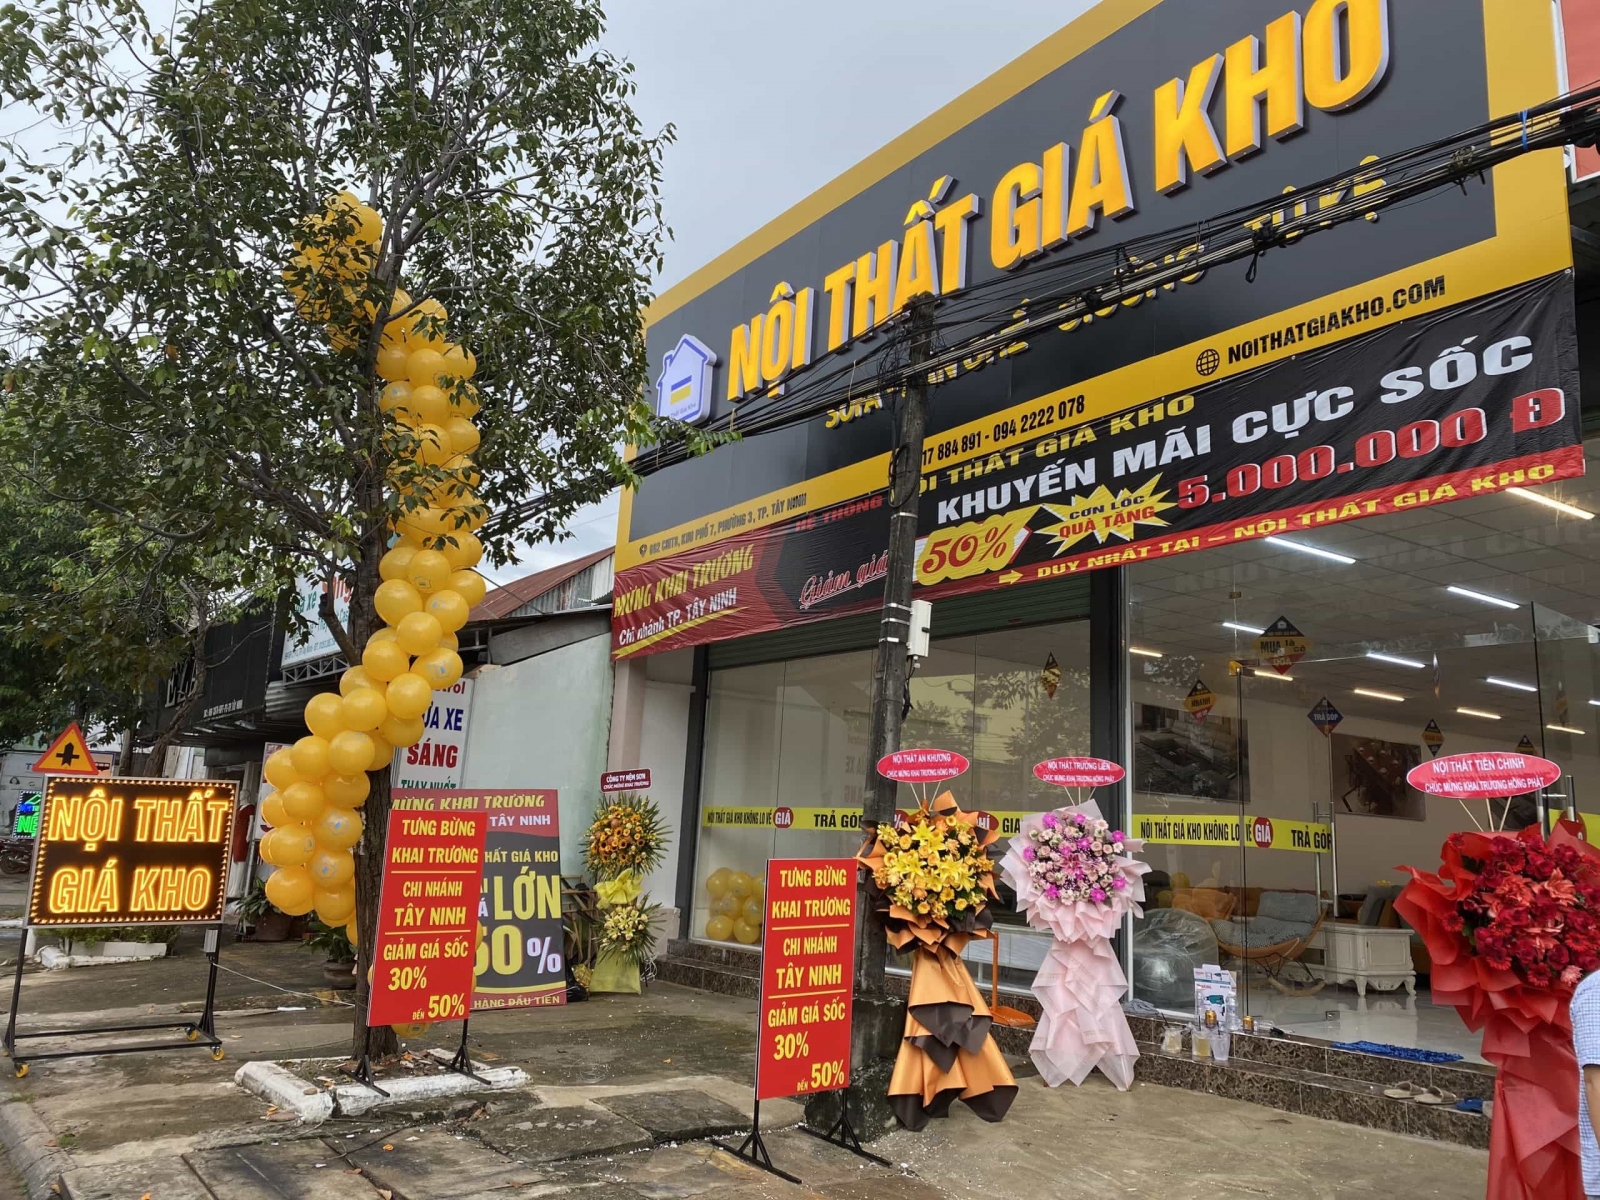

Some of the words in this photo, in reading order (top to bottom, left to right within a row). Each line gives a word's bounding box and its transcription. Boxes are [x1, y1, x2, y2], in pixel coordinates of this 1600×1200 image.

[727, 281, 814, 401] NỘI
[824, 174, 979, 352] THẤT
[991, 89, 1134, 271] GIÁ
[1154, 0, 1389, 195] KHO
[1228, 277, 1445, 364] NOITHATGIAKHO.COM
[938, 439, 958, 460] 884
[962, 431, 981, 453] 891
[994, 419, 1016, 442] 094
[1021, 402, 1053, 433] 2222
[1059, 394, 1085, 420] 078
[1110, 394, 1195, 436] KHO
[938, 457, 1095, 525] KHUYẾN
[1113, 425, 1210, 478] MÃI
[1232, 386, 1354, 443] CỰC
[1380, 335, 1533, 404] SỐC
[1177, 408, 1486, 509] 5.000.000
[1510, 387, 1565, 433] Đ
[748, 512, 755, 524] 3,
[757, 506, 768, 520] TP.
[772, 499, 785, 515] TÂY
[1037, 561, 1079, 578] DUY
[1087, 545, 1152, 568] NHẤT
[1160, 536, 1199, 553] TẠI
[1234, 517, 1287, 540] NỘI
[1298, 498, 1382, 526] THẤT
[1395, 482, 1457, 508] GIÁ
[1471, 464, 1554, 492] KHO
[1069, 504, 1104, 520] CƠN
[1111, 494, 1144, 511] LỐC
[1059, 516, 1096, 538] QUÀ
[1103, 505, 1156, 529] TẶNG
[922, 522, 1014, 575] 50%
[655, 570, 688, 603] KHAI
[693, 544, 754, 589] TRƯƠNG
[619, 627, 635, 645] Chi
[637, 616, 664, 640] nhánh
[667, 609, 683, 628] TP.
[686, 597, 706, 622] TÂY
[709, 587, 737, 613] NINH
[443, 707, 463, 731] XE
[406, 738, 458, 768] SÁNG
[440, 797, 478, 810] KHAI
[484, 794, 545, 809] TRƯƠNG
[47, 788, 124, 851] NỘI
[134, 788, 228, 842] THẤT
[402, 817, 437, 836] TƯNG
[440, 816, 476, 836] BỪNG
[490, 813, 515, 826] TÂY
[520, 815, 550, 826] NINH
[775, 809, 791, 825] GIÁ
[814, 810, 836, 827] TRẢ
[1140, 819, 1153, 842] NỘI
[1154, 816, 1171, 839] THẤT
[1173, 820, 1185, 840] GIÁ
[1187, 821, 1201, 840] KHO
[1204, 819, 1229, 841] KHÔNG
[1231, 823, 1240, 842] LO
[1255, 822, 1271, 843] GIÁ
[1291, 824, 1311, 847] TRẢ
[391, 847, 424, 863] KHAI
[428, 845, 478, 864] TRƯƠNG
[484, 847, 508, 863] HẤT
[511, 849, 531, 863] GIÁ
[535, 851, 558, 863] KHO
[50, 857, 118, 913] GIÁ
[129, 868, 211, 912] KHO
[403, 881, 422, 897] CHI
[425, 877, 462, 897] NHÁNH
[780, 866, 811, 888] TƯNG
[815, 865, 847, 887] BỪNG
[494, 866, 561, 920] LỚN
[394, 902, 425, 926] TÂY
[429, 907, 466, 926] NINH
[771, 901, 800, 919] KHAI
[805, 896, 850, 918] TRƯƠNG
[383, 937, 416, 960] GIẢM
[420, 938, 440, 959] GIÁ
[444, 936, 468, 958] SỐC
[783, 937, 800, 956] CHI
[803, 932, 837, 955] NHÁNH
[388, 966, 427, 991] 30%
[776, 962, 804, 989] TÂY
[809, 964, 842, 987] NINH
[412, 1008, 424, 1020] ĐẾN
[428, 993, 465, 1018] 50%
[474, 998, 504, 1009] HÀNG
[768, 1001, 798, 1027] GIẢM
[801, 1001, 819, 1025] GIÁ
[823, 996, 846, 1021] SỐC
[773, 1031, 809, 1060] 30%
[797, 1077, 808, 1092] ĐẾN
[810, 1059, 845, 1088] 50%
